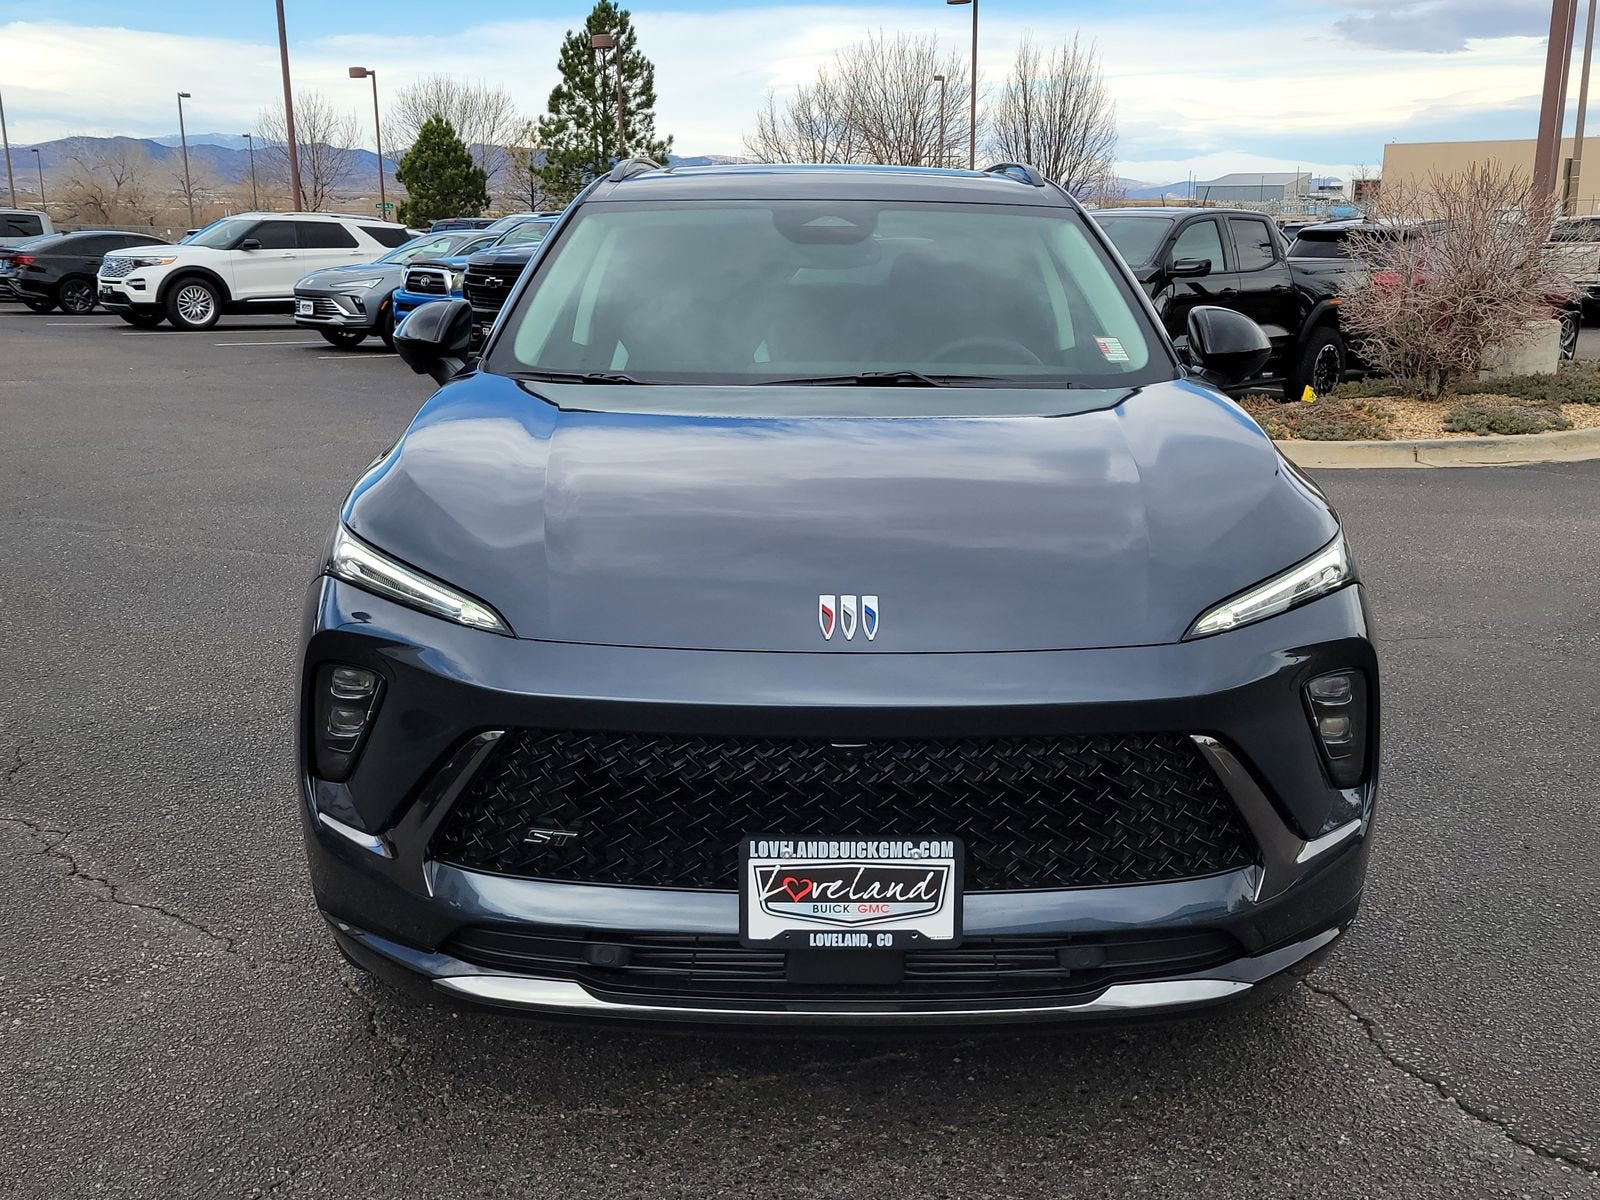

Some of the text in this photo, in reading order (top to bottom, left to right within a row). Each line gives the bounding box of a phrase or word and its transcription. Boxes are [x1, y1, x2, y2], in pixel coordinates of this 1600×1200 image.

[749, 840, 954, 859] LOVELANDBUICKGMCCOM
[812, 903, 890, 914] BUICK GMC
[809, 932, 893, 948] LOVELAND, CO
